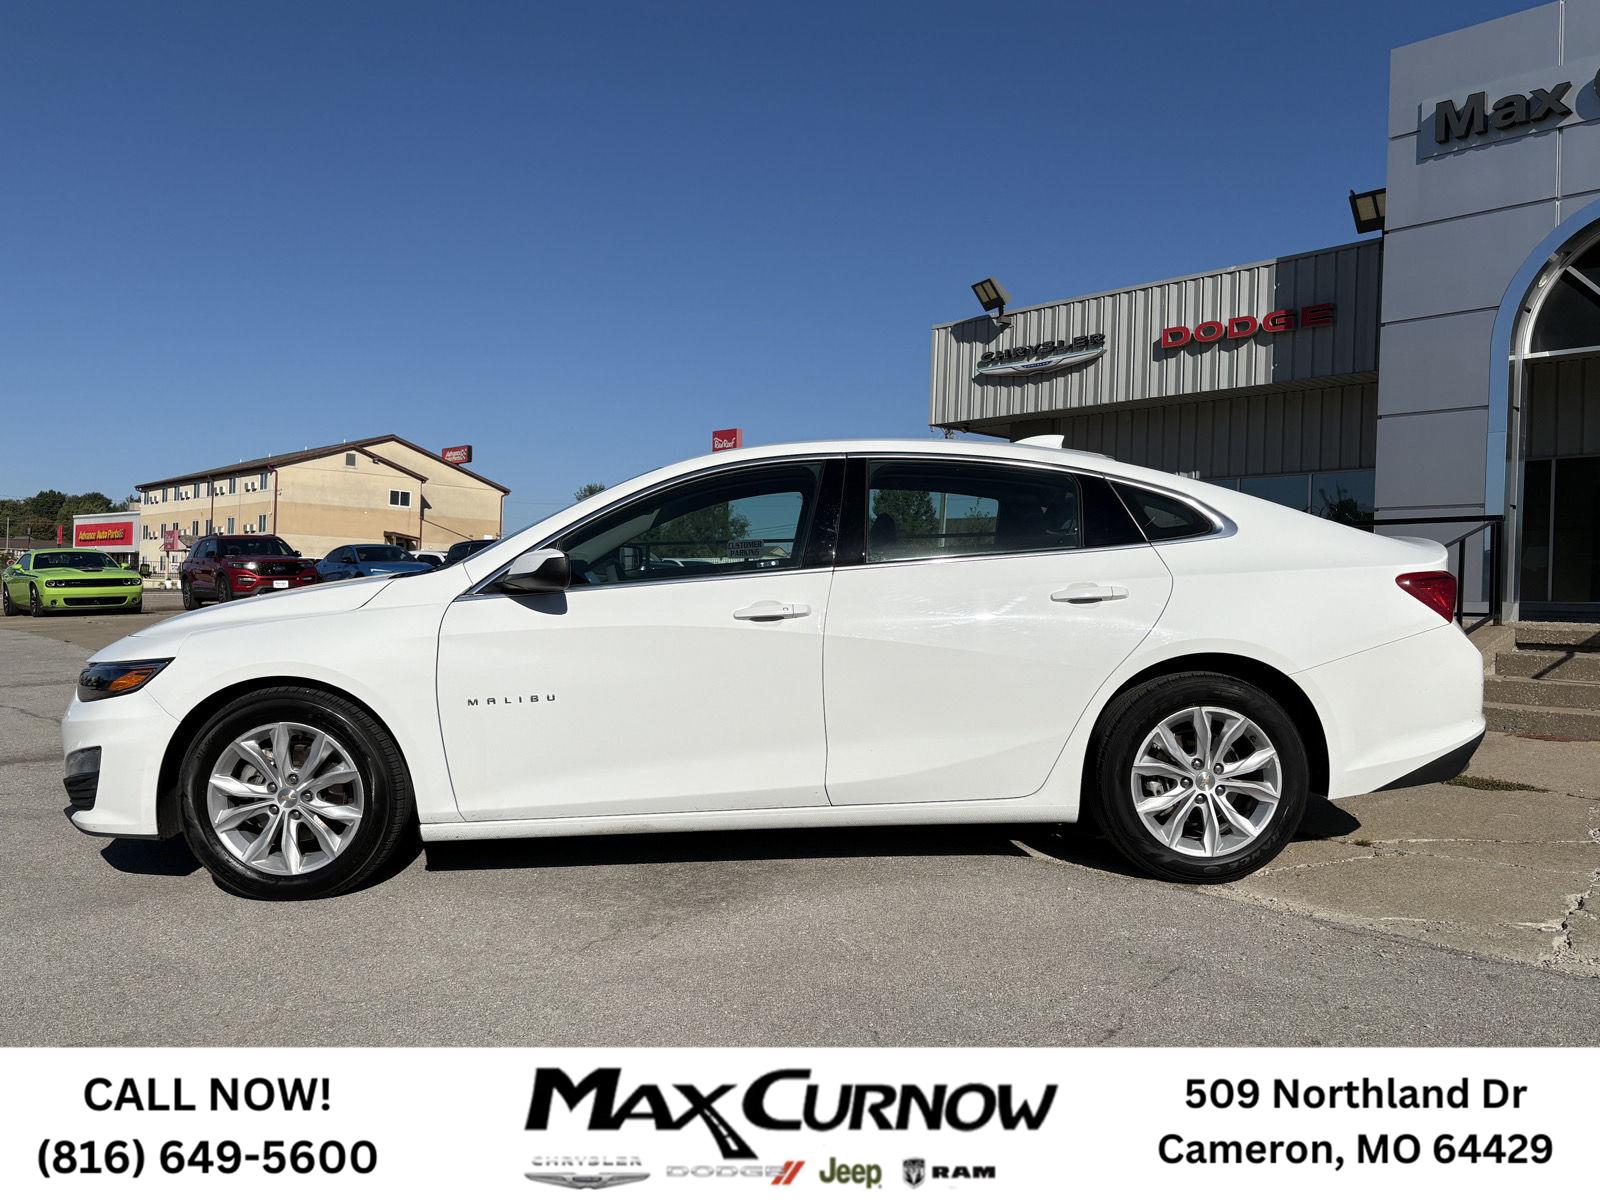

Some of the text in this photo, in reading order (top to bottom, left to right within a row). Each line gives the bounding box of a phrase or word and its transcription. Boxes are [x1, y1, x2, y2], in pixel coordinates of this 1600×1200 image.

[1435, 81, 1573, 144] Max
[1161, 303, 1335, 348] DODGE
[980, 333, 1106, 361] CHRYSLER
[728, 540, 762, 549] CUSTOMER
[730, 549, 760, 557] PARKING
[467, 694, 556, 706] MALIBU
